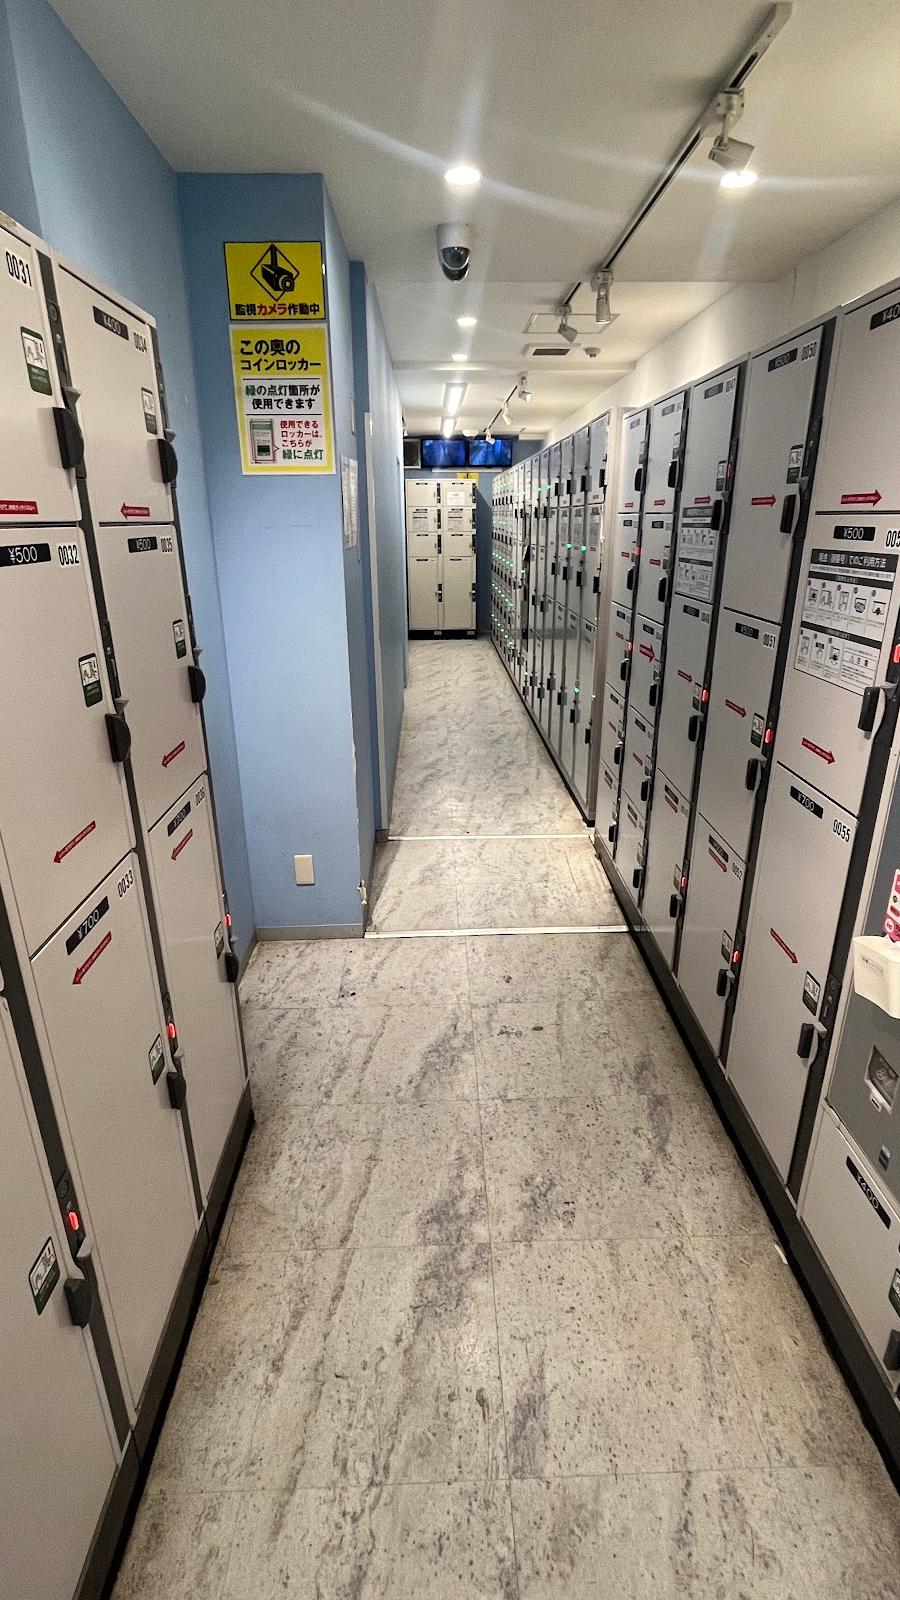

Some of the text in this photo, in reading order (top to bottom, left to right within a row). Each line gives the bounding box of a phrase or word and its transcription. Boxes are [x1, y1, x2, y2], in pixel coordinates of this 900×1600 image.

[6, 251, 32, 287] 0031
[235, 303, 320, 316] 監視カメラ作動中
[882, 304, 900, 321] ¥40
[240, 339, 301, 356] この奥の
[241, 358, 322, 371] コインロッカー
[245, 384, 320, 396] 緑の点灯箇所が
[252, 398, 316, 410] 使用できます
[280, 420, 319, 429] 使用できる
[282, 439, 313, 448] こちらが
[282, 449, 324, 460] 緑に点灯
[843, 527, 865, 540] ¥500
[885, 530, 900, 548] 005
[136, 538, 151, 550] ¥500
[7, 546, 38, 563] ¥500
[58, 544, 79, 566] 0032
[797, 793, 815, 811] ¥700
[833, 819, 851, 842] 0055
[117, 869, 134, 898] 0033
[77, 909, 100, 940] ¥700
[857, 1172, 879, 1209] ¥400
